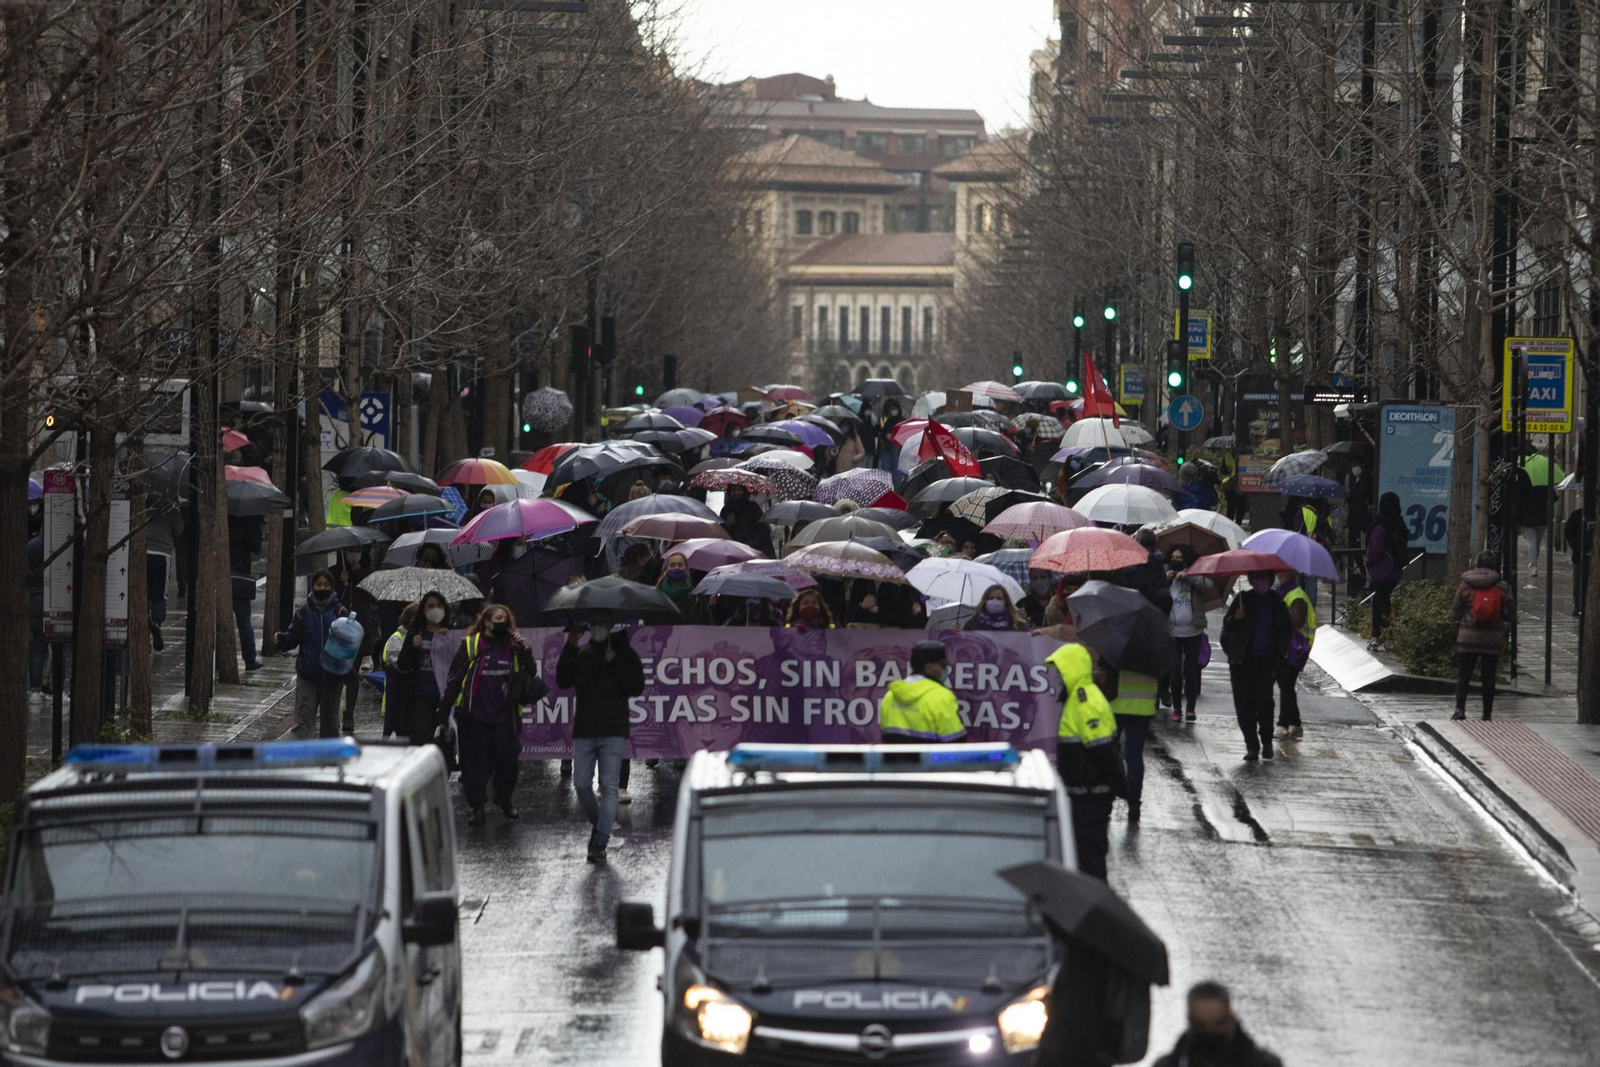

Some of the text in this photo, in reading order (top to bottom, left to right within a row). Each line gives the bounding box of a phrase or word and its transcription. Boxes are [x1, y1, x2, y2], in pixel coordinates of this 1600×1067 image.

[1527, 387, 1557, 400] AXI
[1389, 412, 1438, 421] DECATHLON
[1429, 429, 1455, 467] 2
[1416, 468, 1448, 476] SIEMPRE
[1398, 477, 1446, 486] DISPONIBLES
[1405, 504, 1449, 542] 36
[642, 657, 1056, 695] ECHOS, SIN BAERAS.
[730, 695, 790, 724] SIN
[803, 698, 1030, 731] FRORAS.
[530, 745, 567, 754] FEMINISMO
